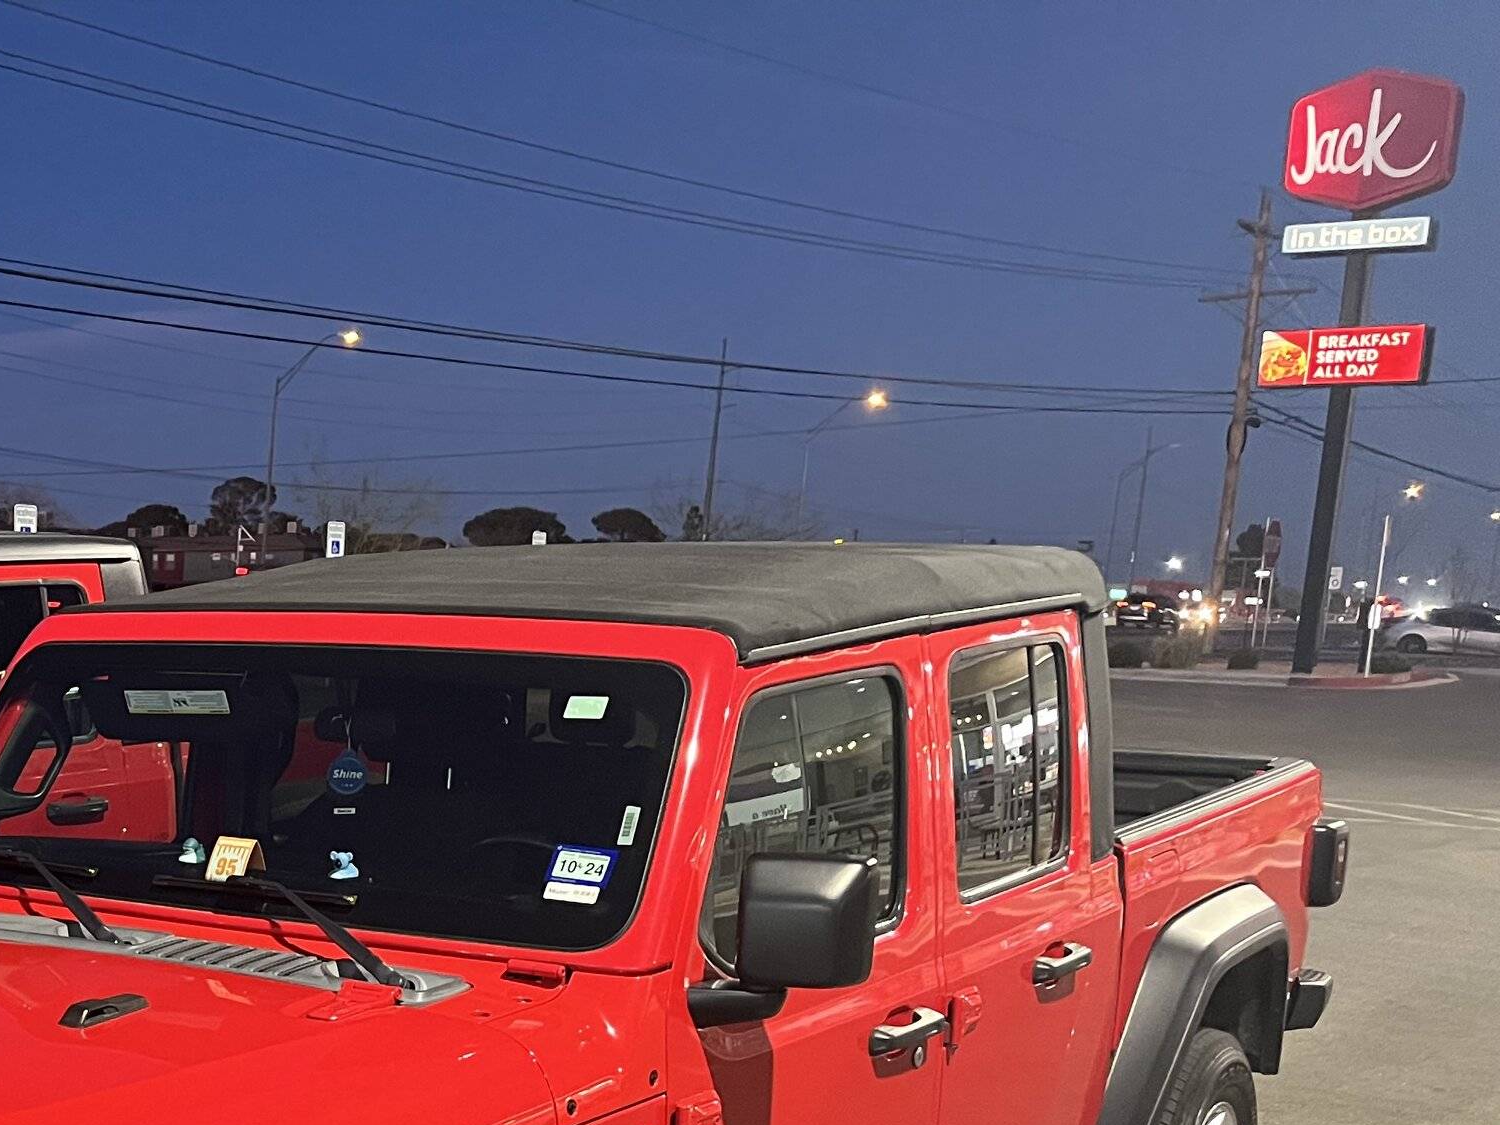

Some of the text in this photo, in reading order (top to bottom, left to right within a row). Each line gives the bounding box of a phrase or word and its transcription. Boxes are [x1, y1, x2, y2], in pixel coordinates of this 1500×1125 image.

[1290, 88, 1437, 185] Jack
[1319, 226, 1364, 247] the
[1367, 222, 1421, 244] box
[1318, 332, 1411, 349] BREAKFAST
[1316, 349, 1379, 364] SERVED
[1313, 363, 1379, 378] ALL DAY
[332, 768, 364, 780] Shine
[215, 857, 238, 876] 95
[560, 860, 605, 876] 10 24
